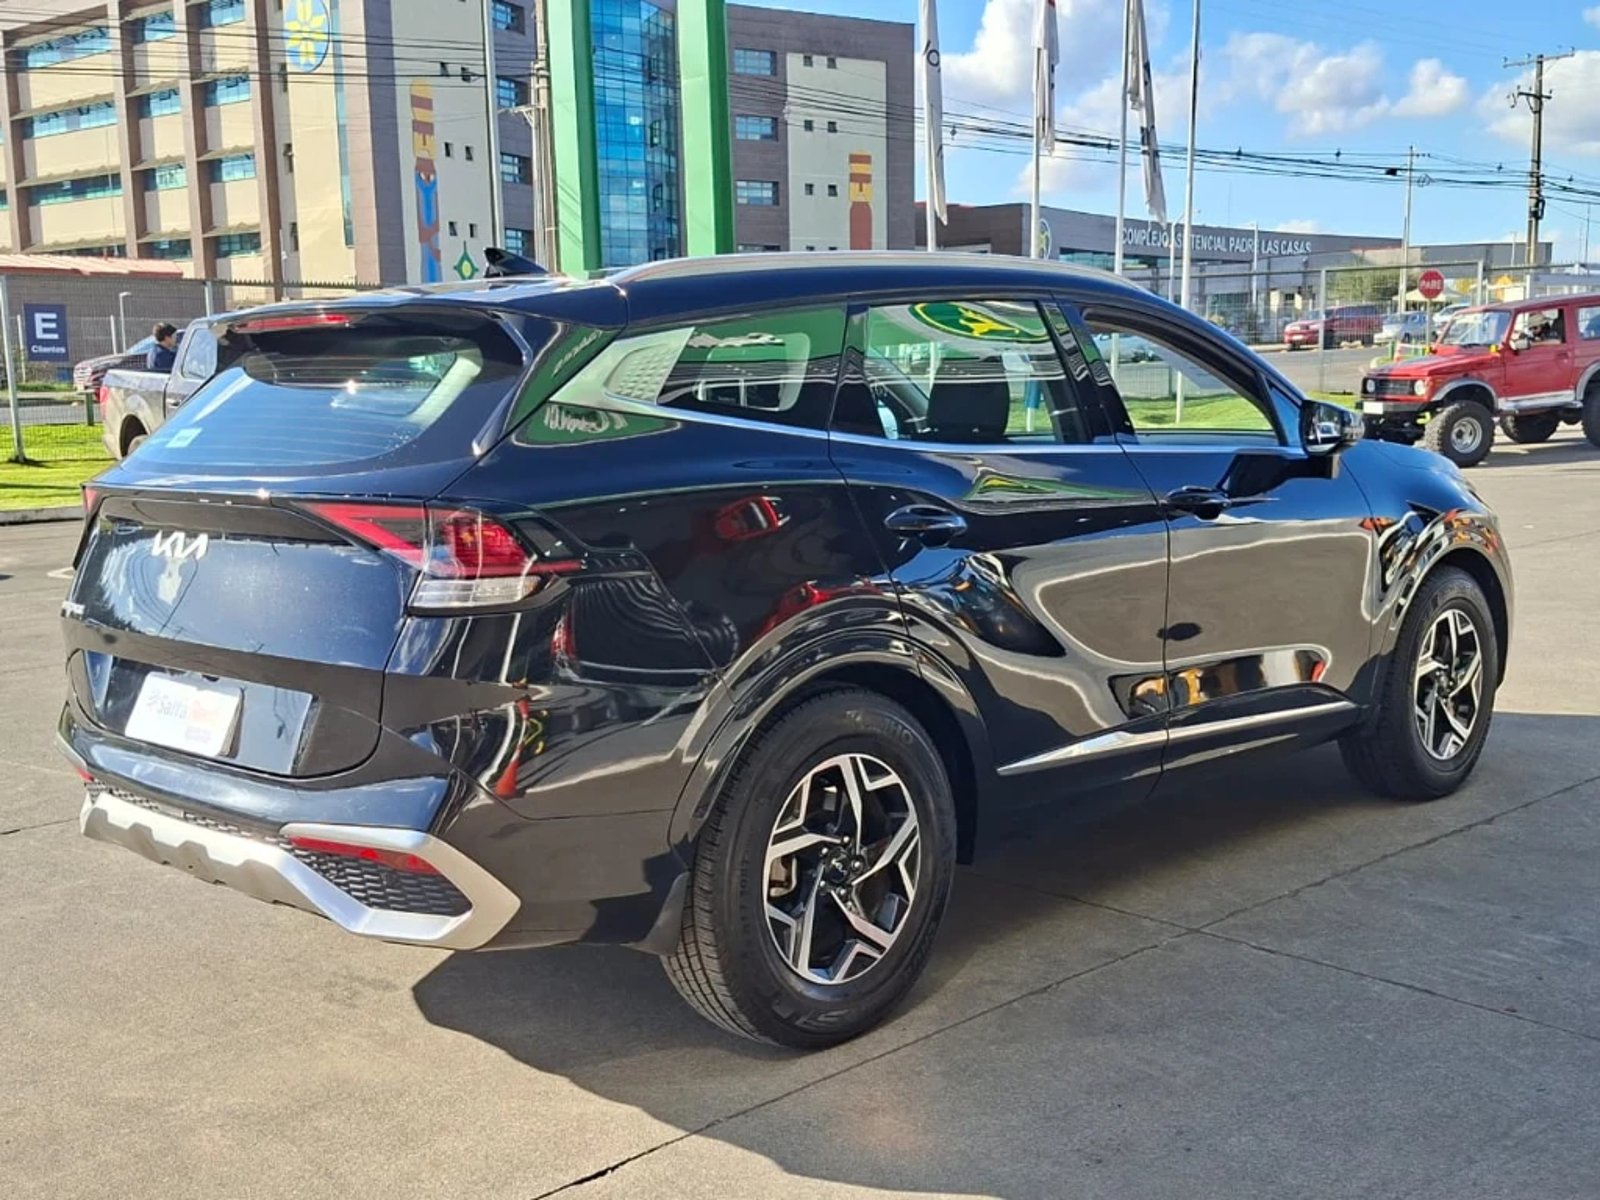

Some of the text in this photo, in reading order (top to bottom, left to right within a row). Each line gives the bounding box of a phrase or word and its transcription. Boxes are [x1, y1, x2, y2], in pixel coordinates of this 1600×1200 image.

[1261, 239, 1279, 254] LAS
[1280, 239, 1312, 255] CASAS
[1420, 279, 1442, 290] PARE
[34, 312, 59, 339] E
[151, 530, 209, 560] KIA
